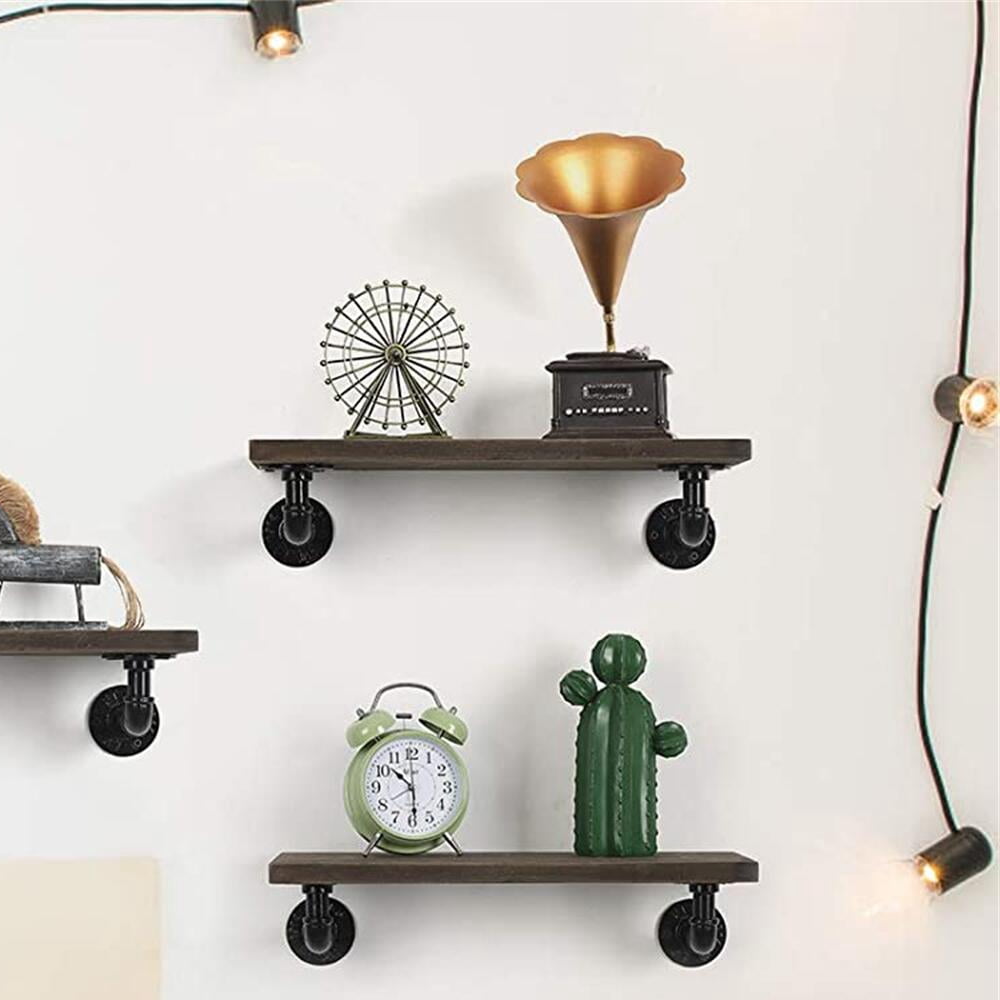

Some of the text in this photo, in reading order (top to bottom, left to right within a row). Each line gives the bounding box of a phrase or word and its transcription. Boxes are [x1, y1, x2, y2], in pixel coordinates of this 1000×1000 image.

[389, 752, 400, 764] 11
[405, 747, 419, 761] 12
[426, 751, 432, 764] 1
[376, 764, 391, 778] 10
[436, 763, 447, 777] 2
[371, 780, 381, 794] 9
[442, 780, 453, 794] 3
[377, 798, 388, 812] 8
[436, 798, 445, 811] 4
[391, 810, 400, 824] 7
[407, 813, 418, 828] 6
[424, 810, 435, 824] 5
